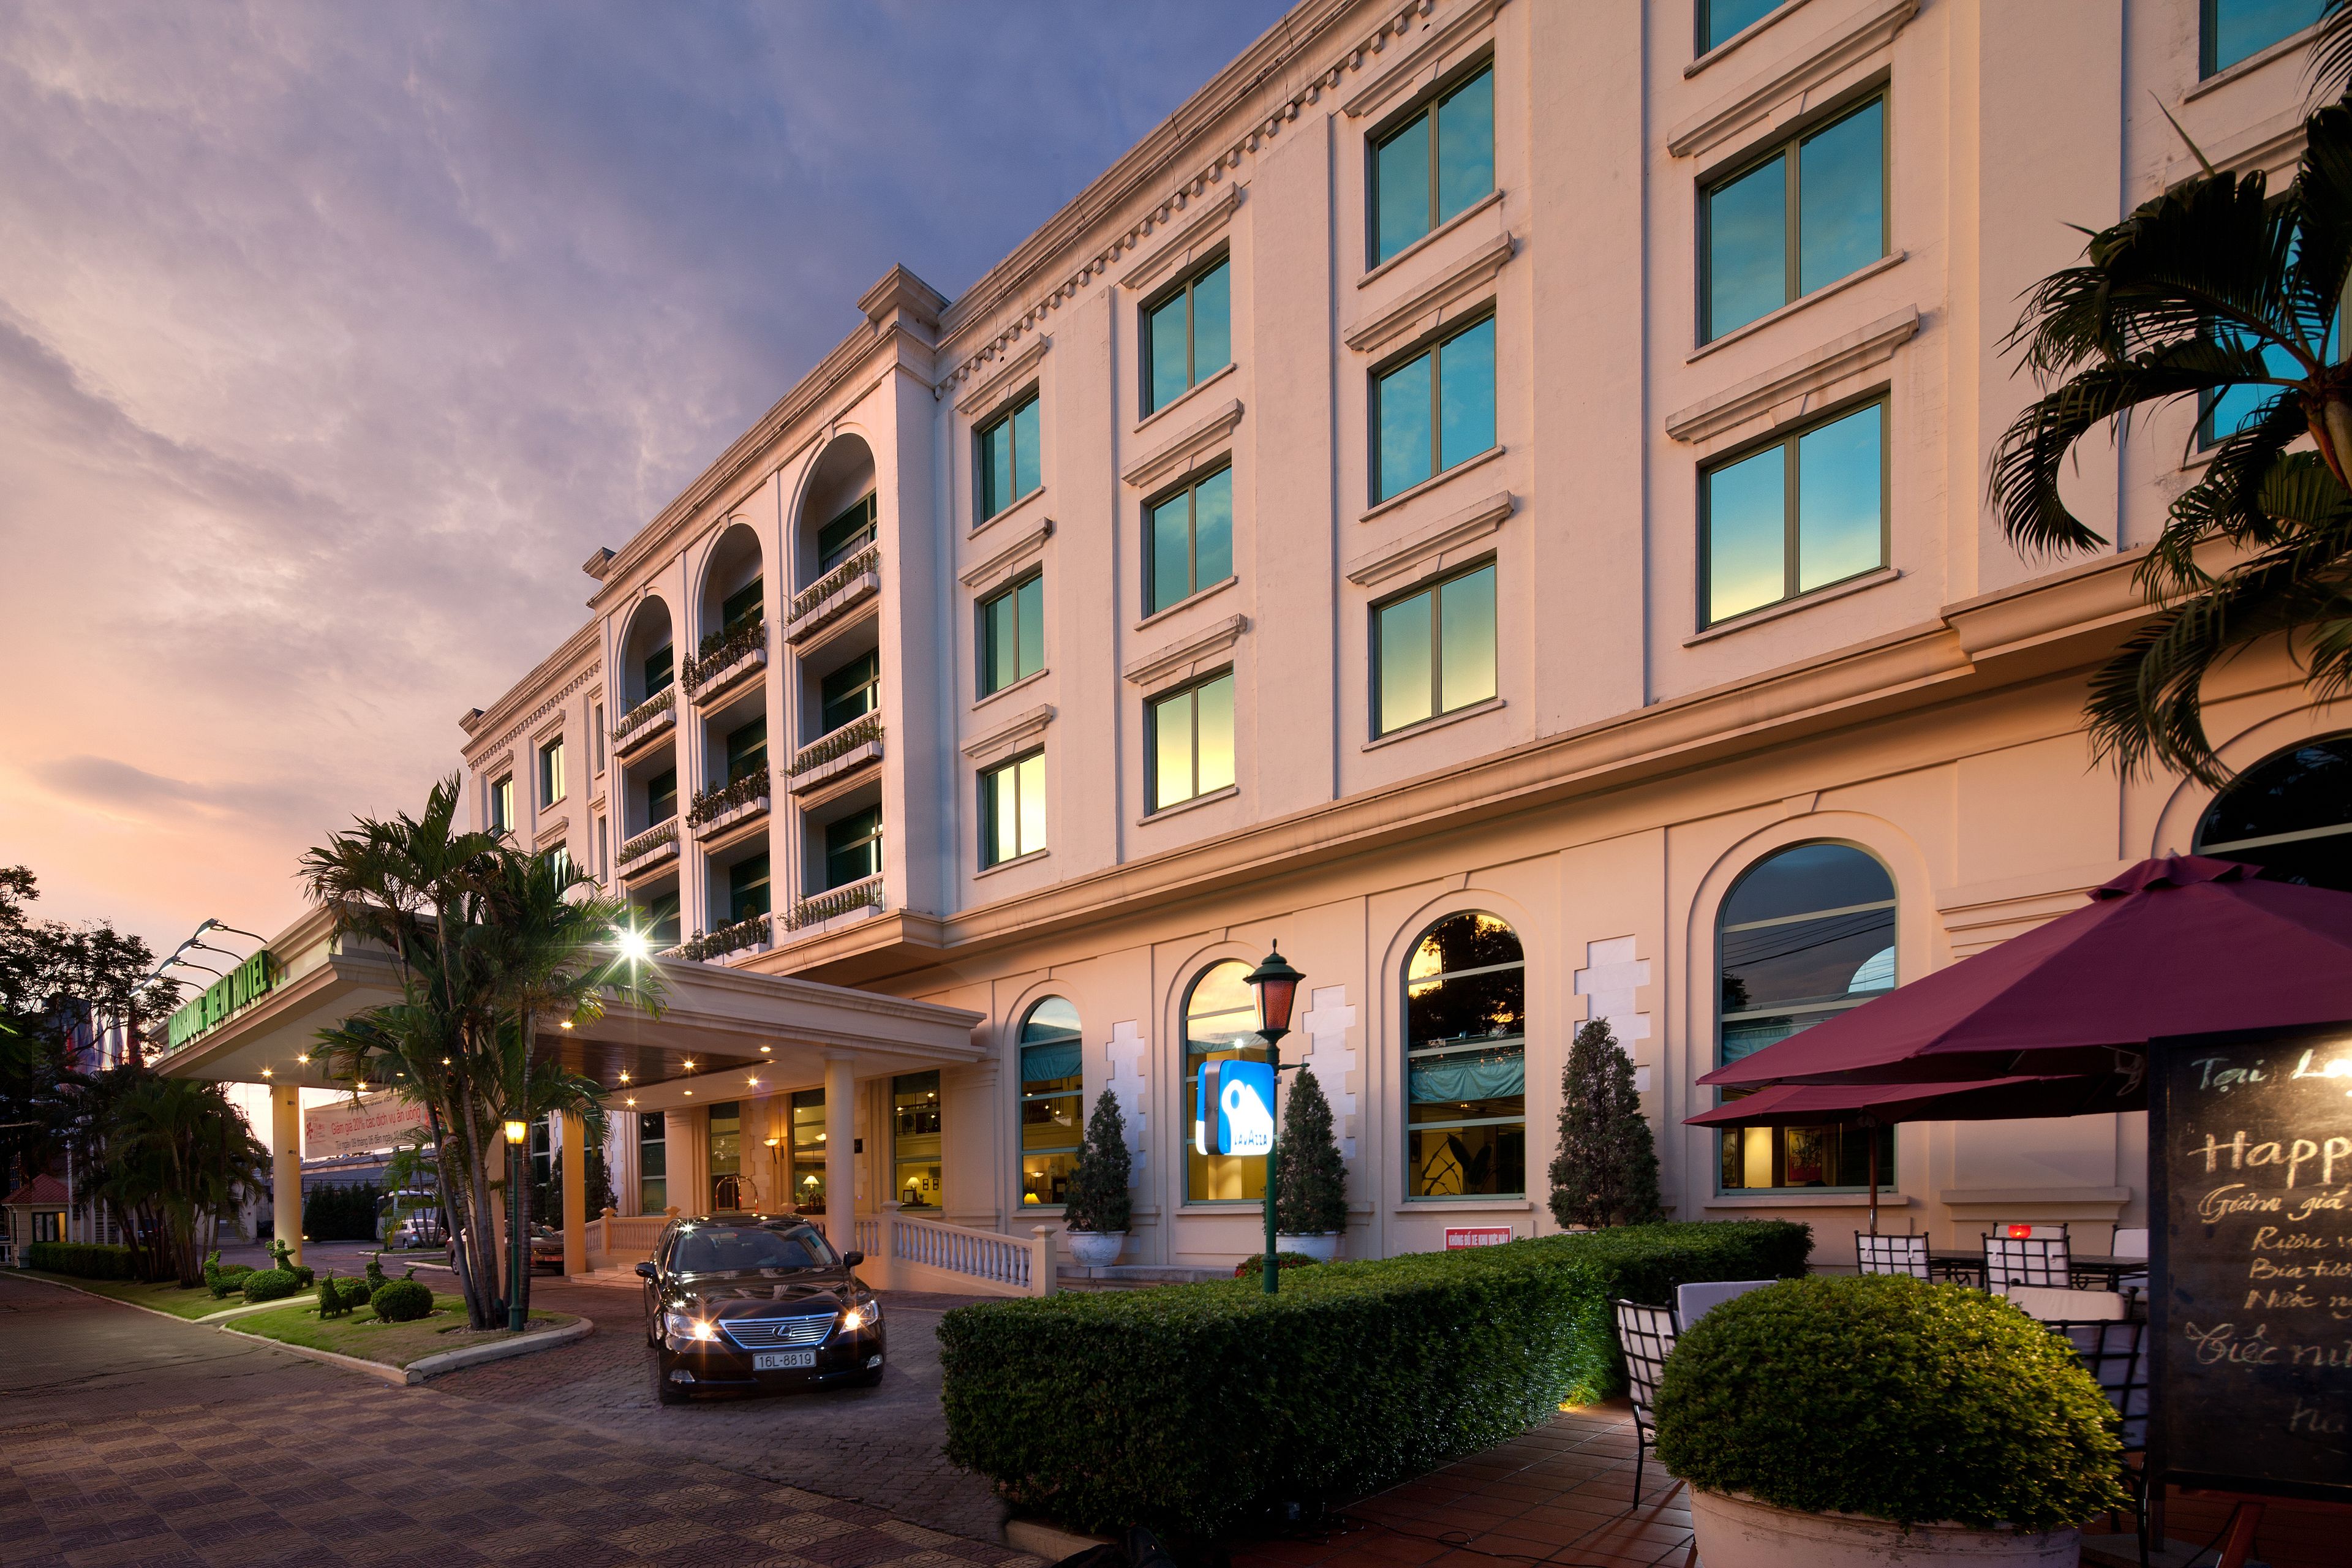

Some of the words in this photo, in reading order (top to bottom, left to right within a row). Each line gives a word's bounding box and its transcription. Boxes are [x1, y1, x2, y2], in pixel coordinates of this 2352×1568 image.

[168, 997, 206, 1049] HARBOUR
[206, 974, 233, 1025] VIEW
[233, 950, 268, 1008] HOTEL
[2191, 1058, 2266, 1092] Tại
[331, 1121, 344, 1135] Giảm
[353, 1117, 366, 1131] 20%
[366, 1115, 375, 1128] các
[376, 1112, 387, 1128] dịch
[389, 1114, 396, 1126] vụ
[397, 1110, 404, 1122] ăn
[406, 1104, 420, 1122] uống
[1234, 1129, 1267, 1145] LAVAZZA
[2187, 1131, 2352, 1189] Happ
[2288, 1190, 2350, 1221] giá
[1472, 1234, 1477, 1246] XE
[1479, 1234, 1488, 1246] KHU
[2249, 1258, 2307, 1279] Bia
[759, 1353, 812, 1368] 16L-8819
